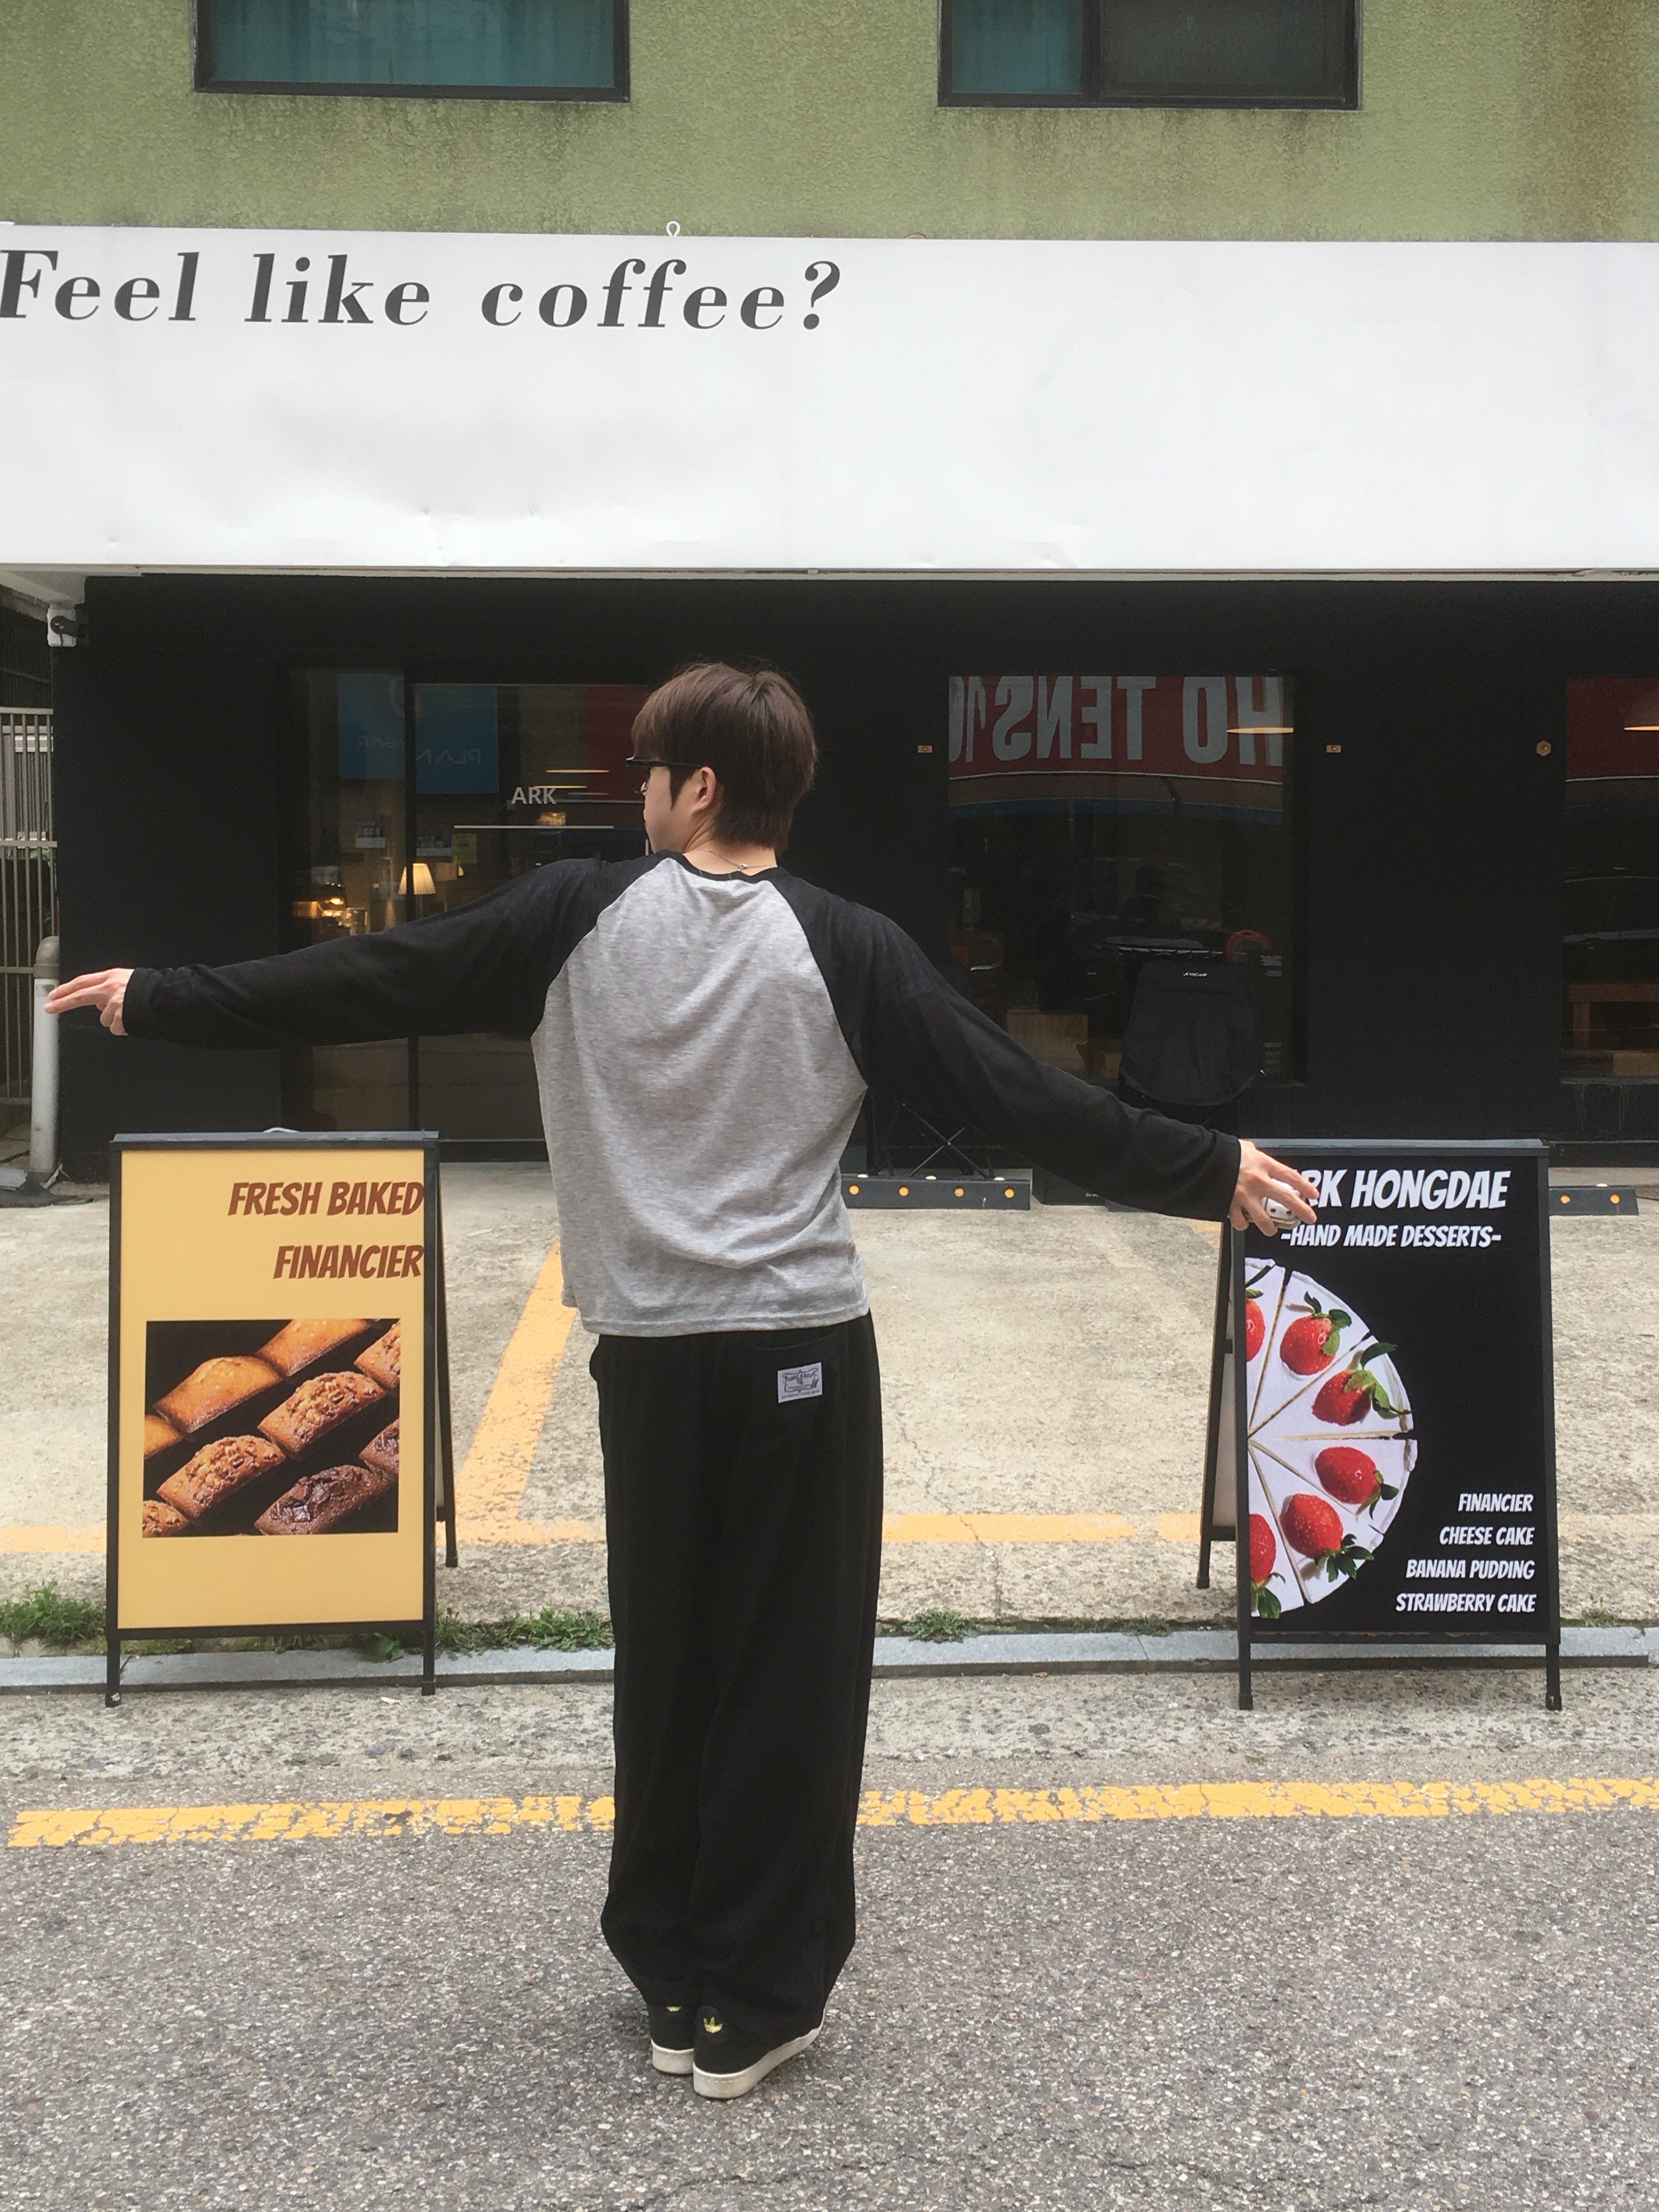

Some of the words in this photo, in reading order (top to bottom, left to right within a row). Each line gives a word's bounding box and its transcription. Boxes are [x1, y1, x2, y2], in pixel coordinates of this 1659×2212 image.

[0, 249, 199, 321] Feel
[245, 254, 429, 325] like
[482, 258, 840, 330] coffee?
[511, 786, 557, 805] ARK
[228, 1182, 323, 1216] FRESH
[326, 1181, 423, 1216] BAKED
[1351, 1169, 1511, 1210] HONGDAE
[1343, 1224, 1398, 1247] MADE
[273, 1244, 423, 1279] FINANCIER
[1458, 1493, 1534, 1513] FINANCIER
[1439, 1527, 1493, 1545] CHEESE
[1495, 1527, 1535, 1546] CAKE
[1405, 1560, 1466, 1578] BANANA
[1469, 1560, 1535, 1579] PUDDING
[1395, 1593, 1496, 1612] STRAWBERRY
[1497, 1594, 1537, 1613] CAKE
